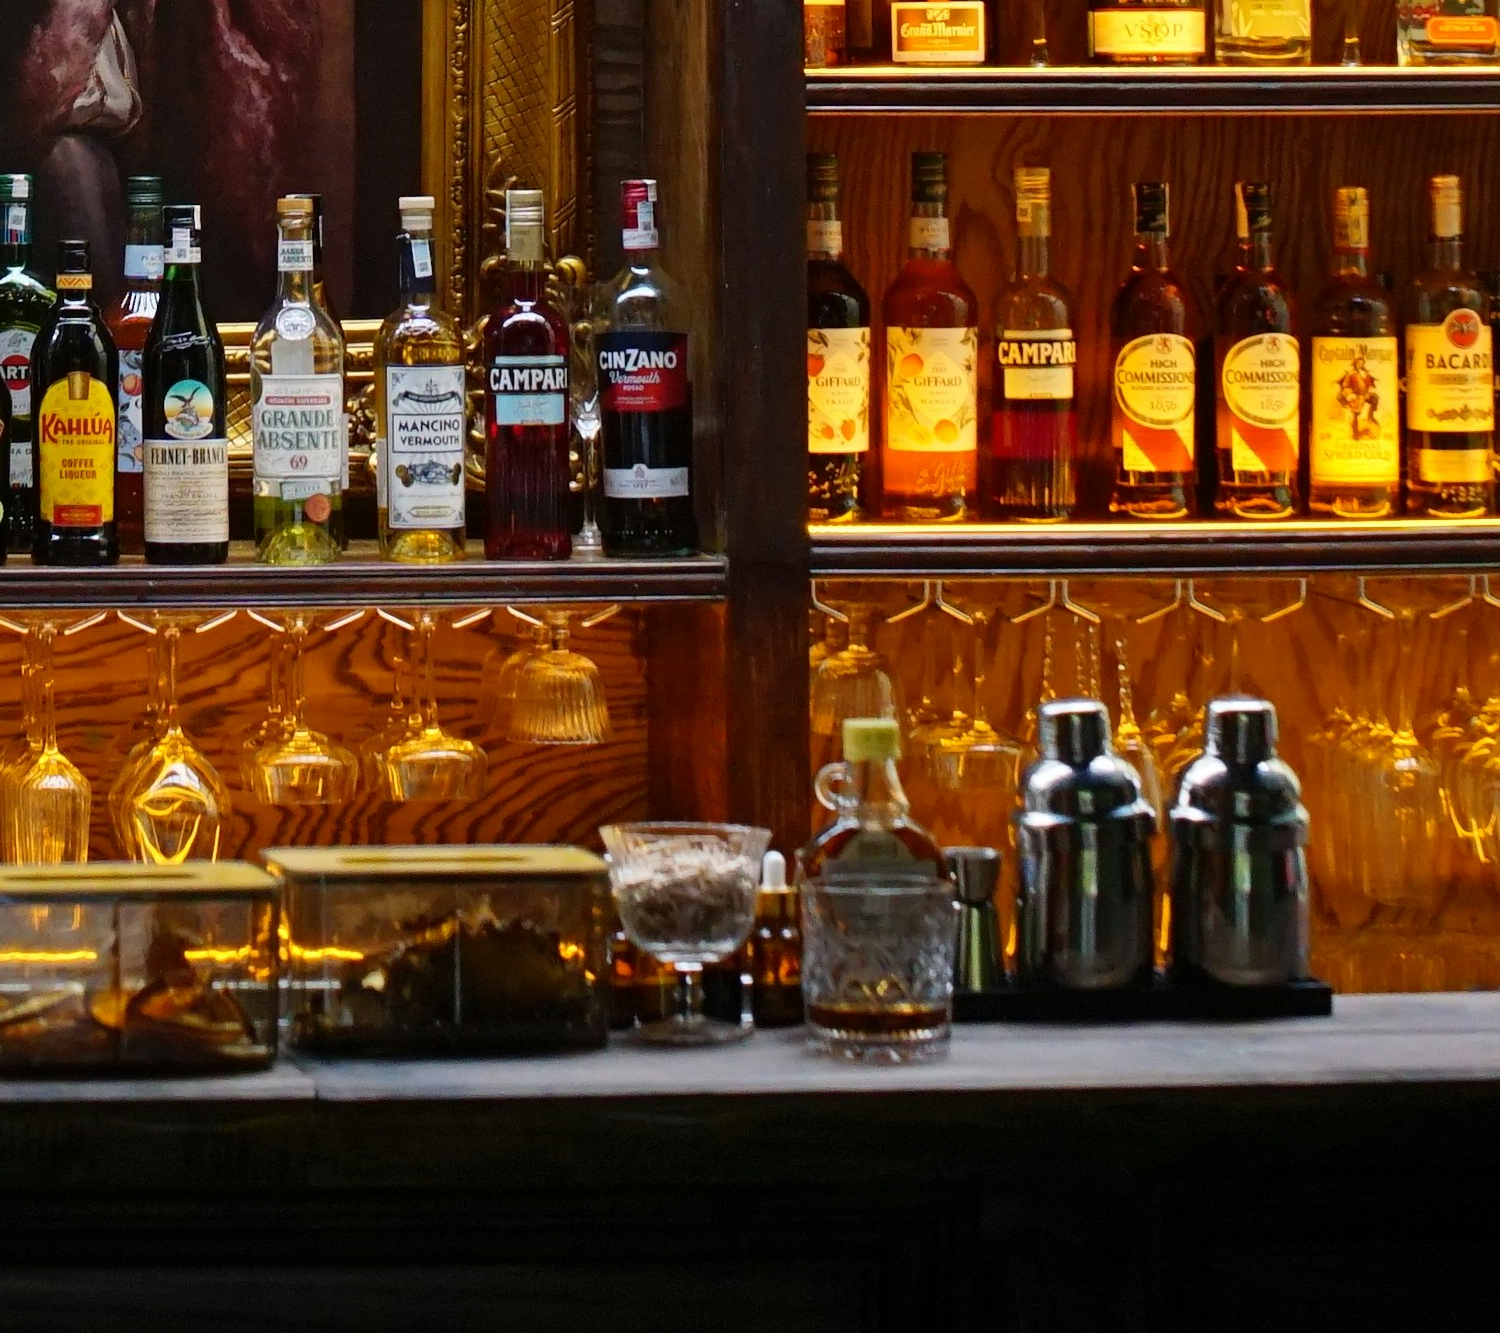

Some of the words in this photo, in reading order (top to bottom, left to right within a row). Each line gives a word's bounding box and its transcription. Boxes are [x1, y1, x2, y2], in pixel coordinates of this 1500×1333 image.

[599, 348, 678, 372] CINZANO
[998, 341, 1077, 365] CAMPARI
[1149, 359, 1178, 369] HIGH
[1259, 359, 1286, 369] HIGH
[1425, 353, 1492, 370] BACARD
[489, 367, 568, 391] CAMPARI
[609, 370, 661, 385] Vermouth
[815, 376, 862, 388] GIFFARD
[918, 376, 968, 388] GIFFARD
[1116, 369, 1196, 385] COMMISSIONE
[622, 384, 645, 392] ROSSO
[261, 410, 335, 430] GRANDE
[398, 419, 461, 433] MANCINO
[41, 412, 114, 445] KAHLÚA
[256, 430, 340, 451] ABSENTE
[400, 435, 460, 447] VERMOUTH
[61, 458, 95, 468] COFFEE
[289, 454, 308, 471] 69
[59, 469, 97, 480] LIQUEUR
